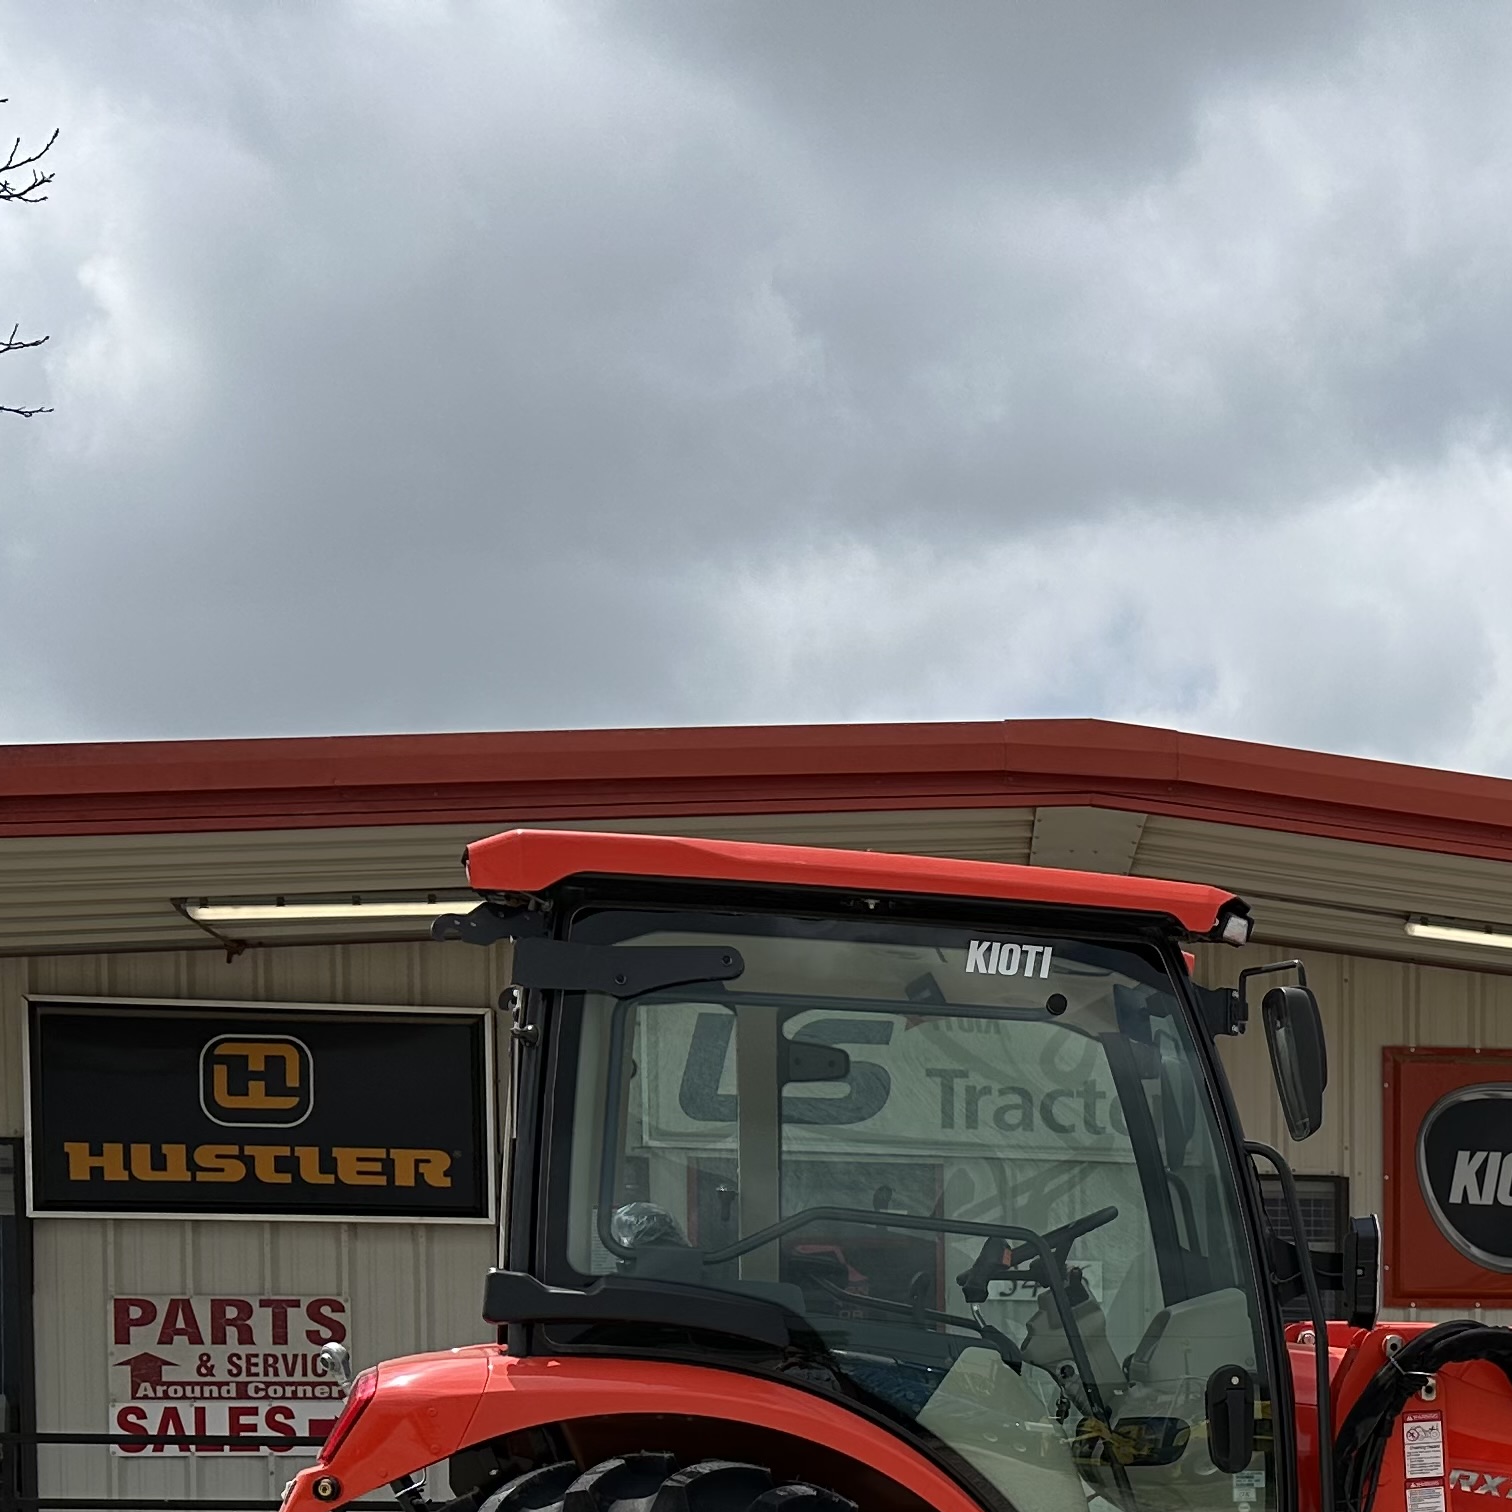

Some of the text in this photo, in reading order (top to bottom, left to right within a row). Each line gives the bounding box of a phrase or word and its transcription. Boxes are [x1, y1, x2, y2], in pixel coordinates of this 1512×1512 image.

[965, 940, 1053, 979] KIOTI
[63, 1141, 452, 1188] HUSTLER
[113, 1298, 347, 1346] PARTS
[196, 1352, 329, 1379] & SERVIC
[136, 1382, 342, 1399] Around Corner
[116, 1405, 298, 1453] SALES
